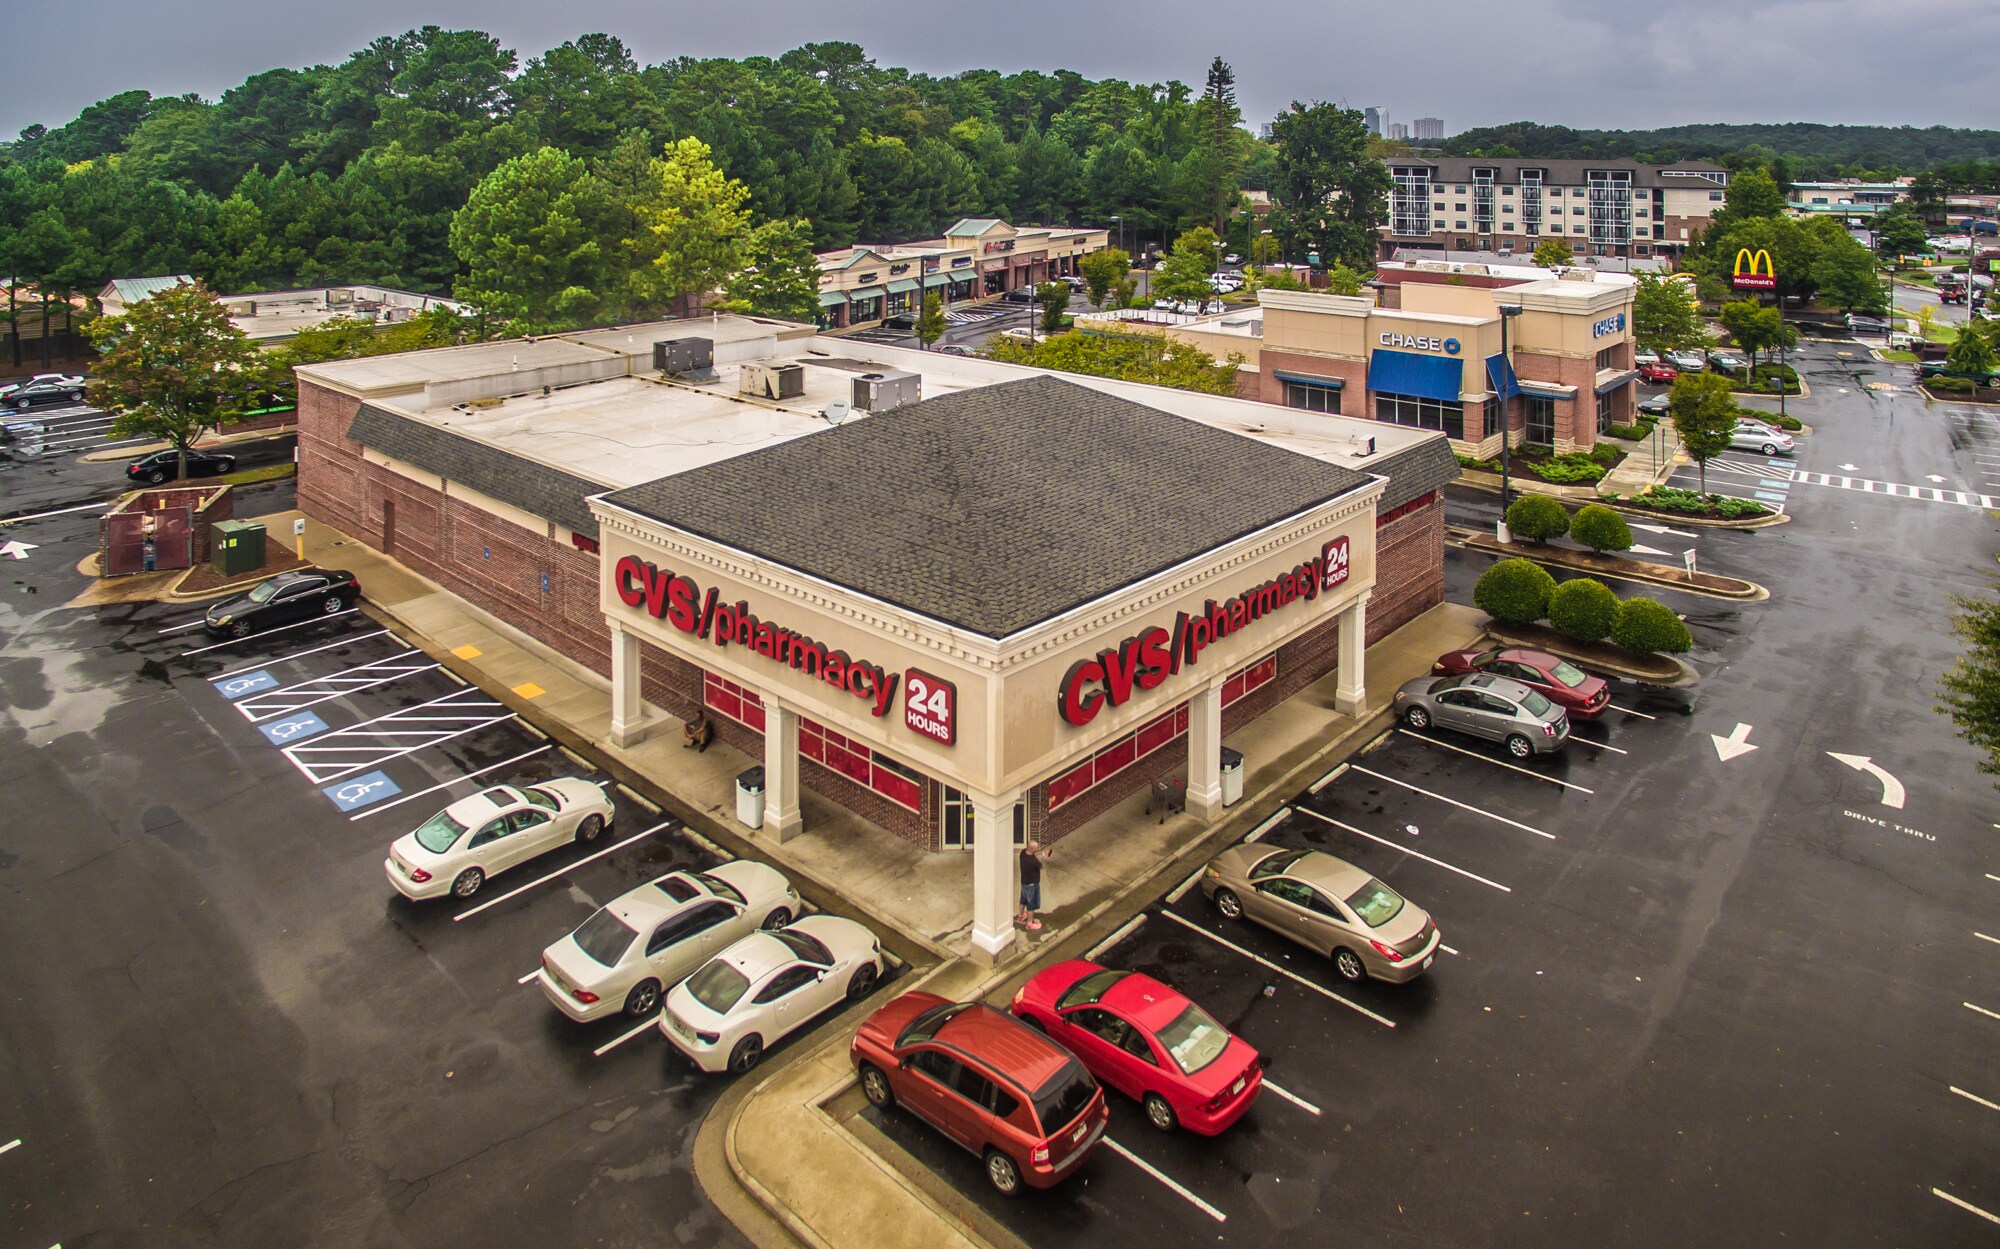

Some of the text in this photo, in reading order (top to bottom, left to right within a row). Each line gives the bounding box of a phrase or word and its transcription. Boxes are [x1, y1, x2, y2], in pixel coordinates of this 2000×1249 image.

[1734, 278, 1774, 286] McDonald's
[1594, 316, 1618, 338] CHASE
[1379, 332, 1441, 351] CHASE
[1327, 542, 1348, 574] 24
[1327, 567, 1348, 586] HOURS
[908, 678, 949, 722] 24
[908, 711, 949, 740] HOURS
[1844, 809, 1936, 842] DRIVE THRU
